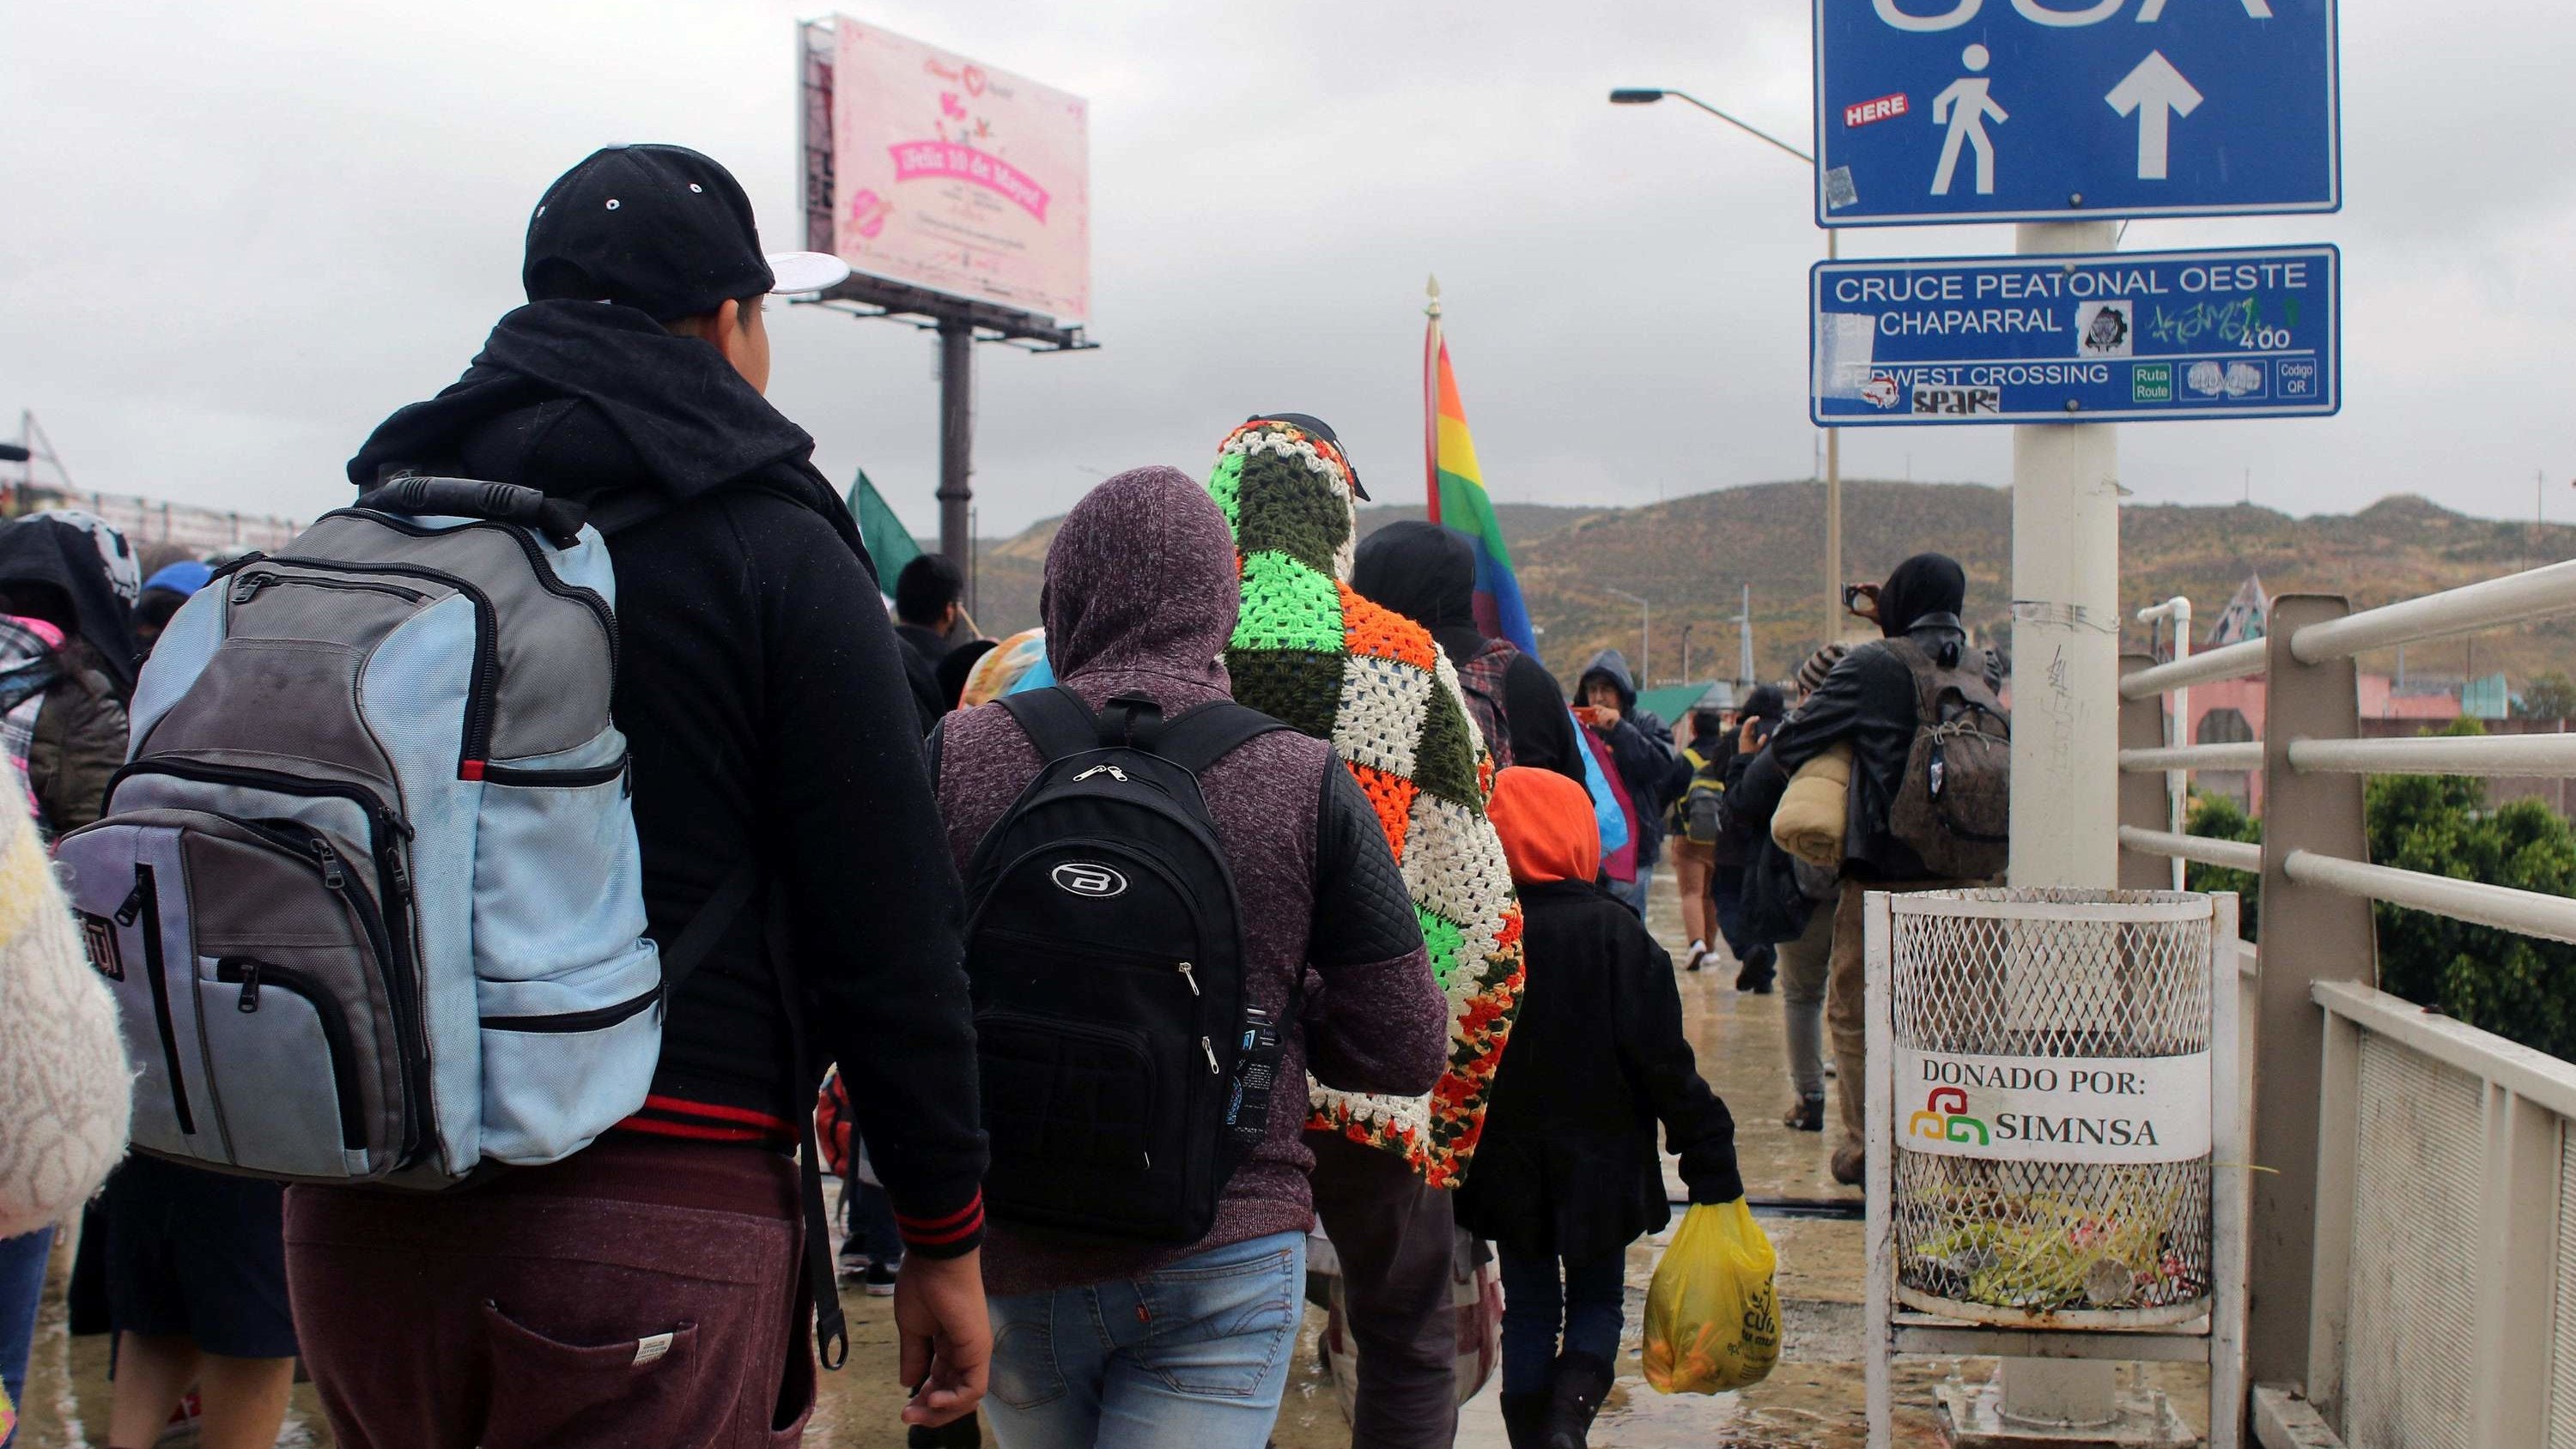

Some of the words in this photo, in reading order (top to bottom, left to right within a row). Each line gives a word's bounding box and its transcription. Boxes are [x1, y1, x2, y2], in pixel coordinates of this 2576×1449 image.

[1846, 95, 1905, 126] HERE
[948, 149, 969, 172] 10
[970, 154, 991, 179] de
[1835, 276, 1963, 301] CRUCE
[1977, 269, 2168, 298] PEATONAL
[2179, 263, 2307, 292] OESTE
[1880, 308, 2063, 335] CHAPARRAL
[2239, 328, 2291, 349] 400
[1970, 363, 2109, 385] CROSSING
[2136, 369, 2167, 382] Ruta
[2287, 379, 2306, 393] QR
[2136, 385, 2168, 398] Route
[1923, 1059, 2057, 1092] DONADO
[2069, 1070, 2145, 1095] POR:
[1996, 1113, 2160, 1146] SIMNSA
